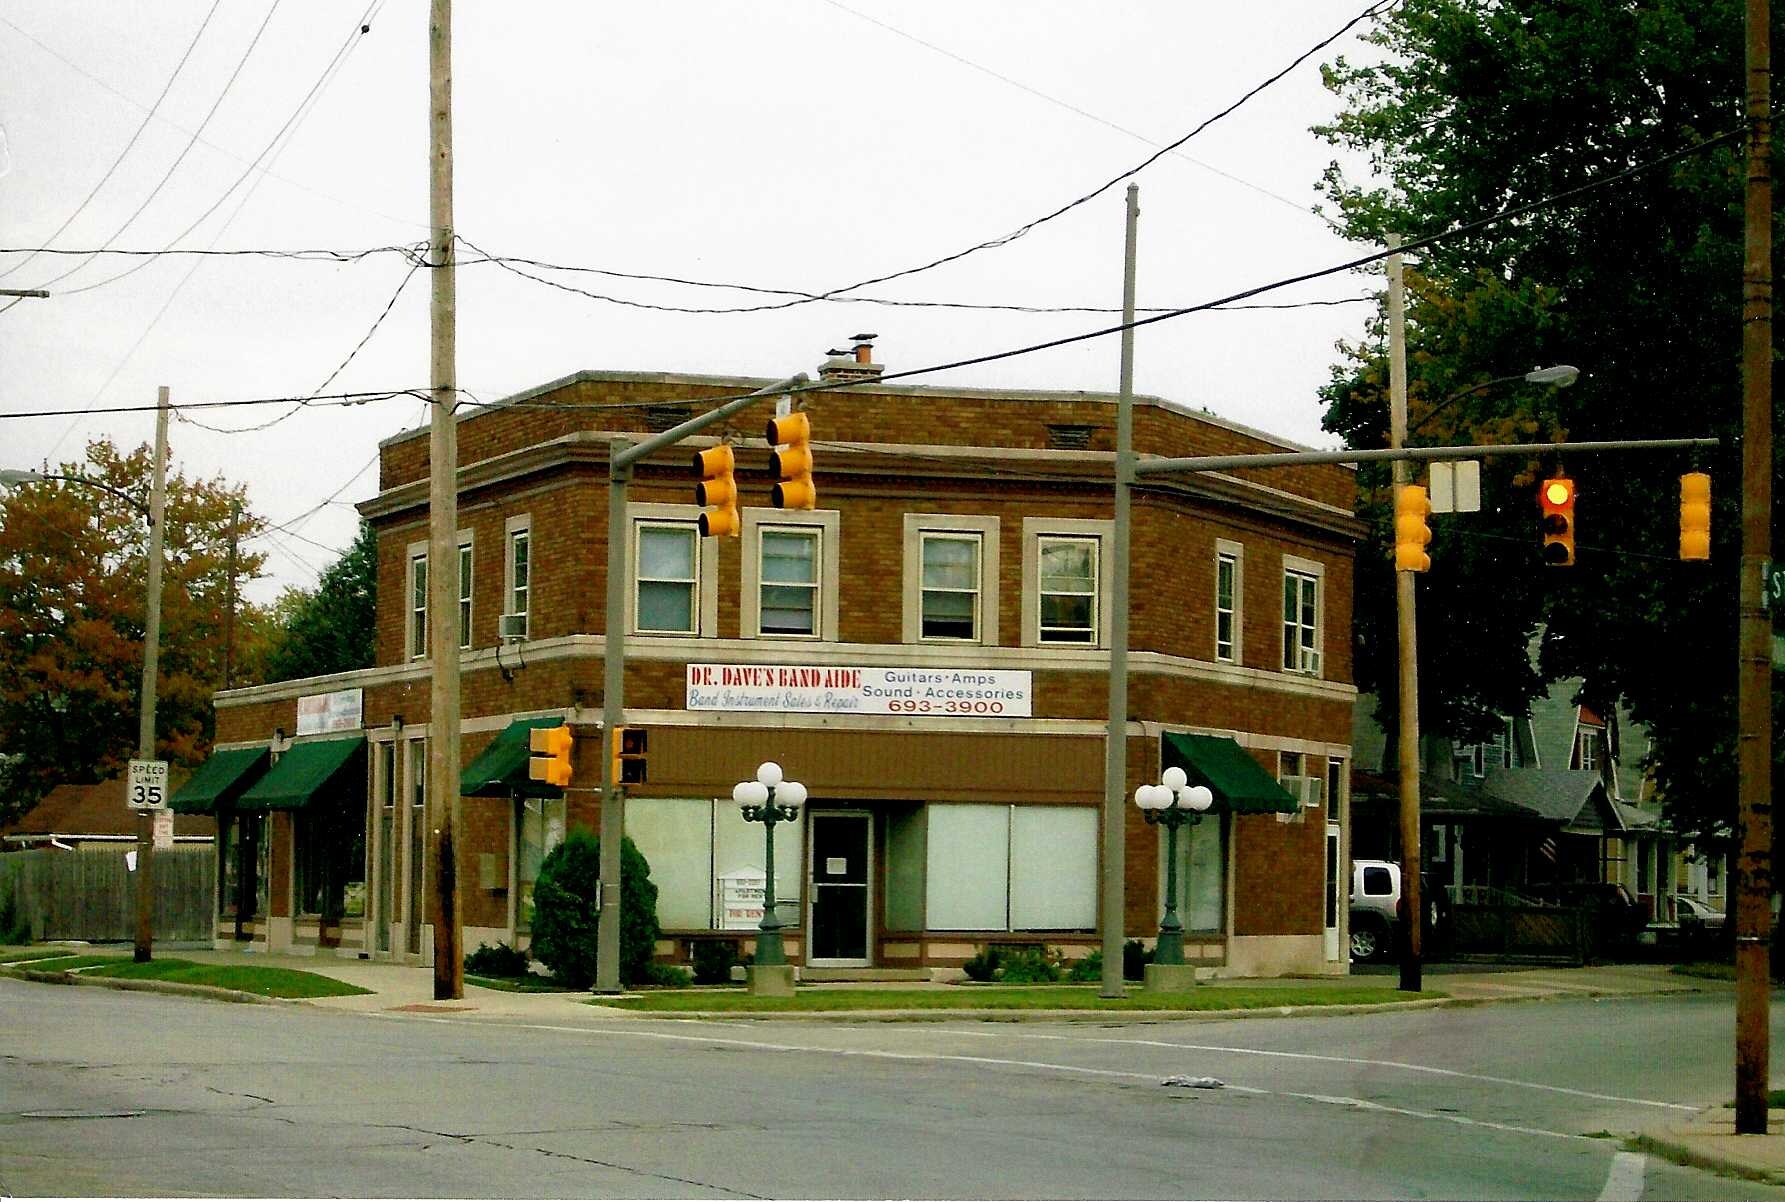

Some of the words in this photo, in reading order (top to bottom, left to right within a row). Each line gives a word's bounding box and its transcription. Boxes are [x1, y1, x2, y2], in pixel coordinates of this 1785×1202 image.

[1773, 570, 1785, 599] S
[691, 666, 718, 686] DR.
[722, 667, 774, 687] DAVE'S
[778, 668, 821, 688] BAND
[824, 669, 861, 689] AIDE
[884, 671, 942, 683] Guitars
[951, 673, 996, 685] Amps
[689, 688, 720, 707] Band
[722, 689, 780, 708] Instrument
[782, 691, 813, 709] Sales
[823, 691, 859, 711] Repair
[862, 685, 913, 698] Sound
[925, 687, 1024, 700] Accessories
[888, 700, 1004, 714] 693-3900
[132, 764, 165, 775] SPEED
[135, 776, 160, 785] LIMIT
[132, 785, 162, 805] 35
